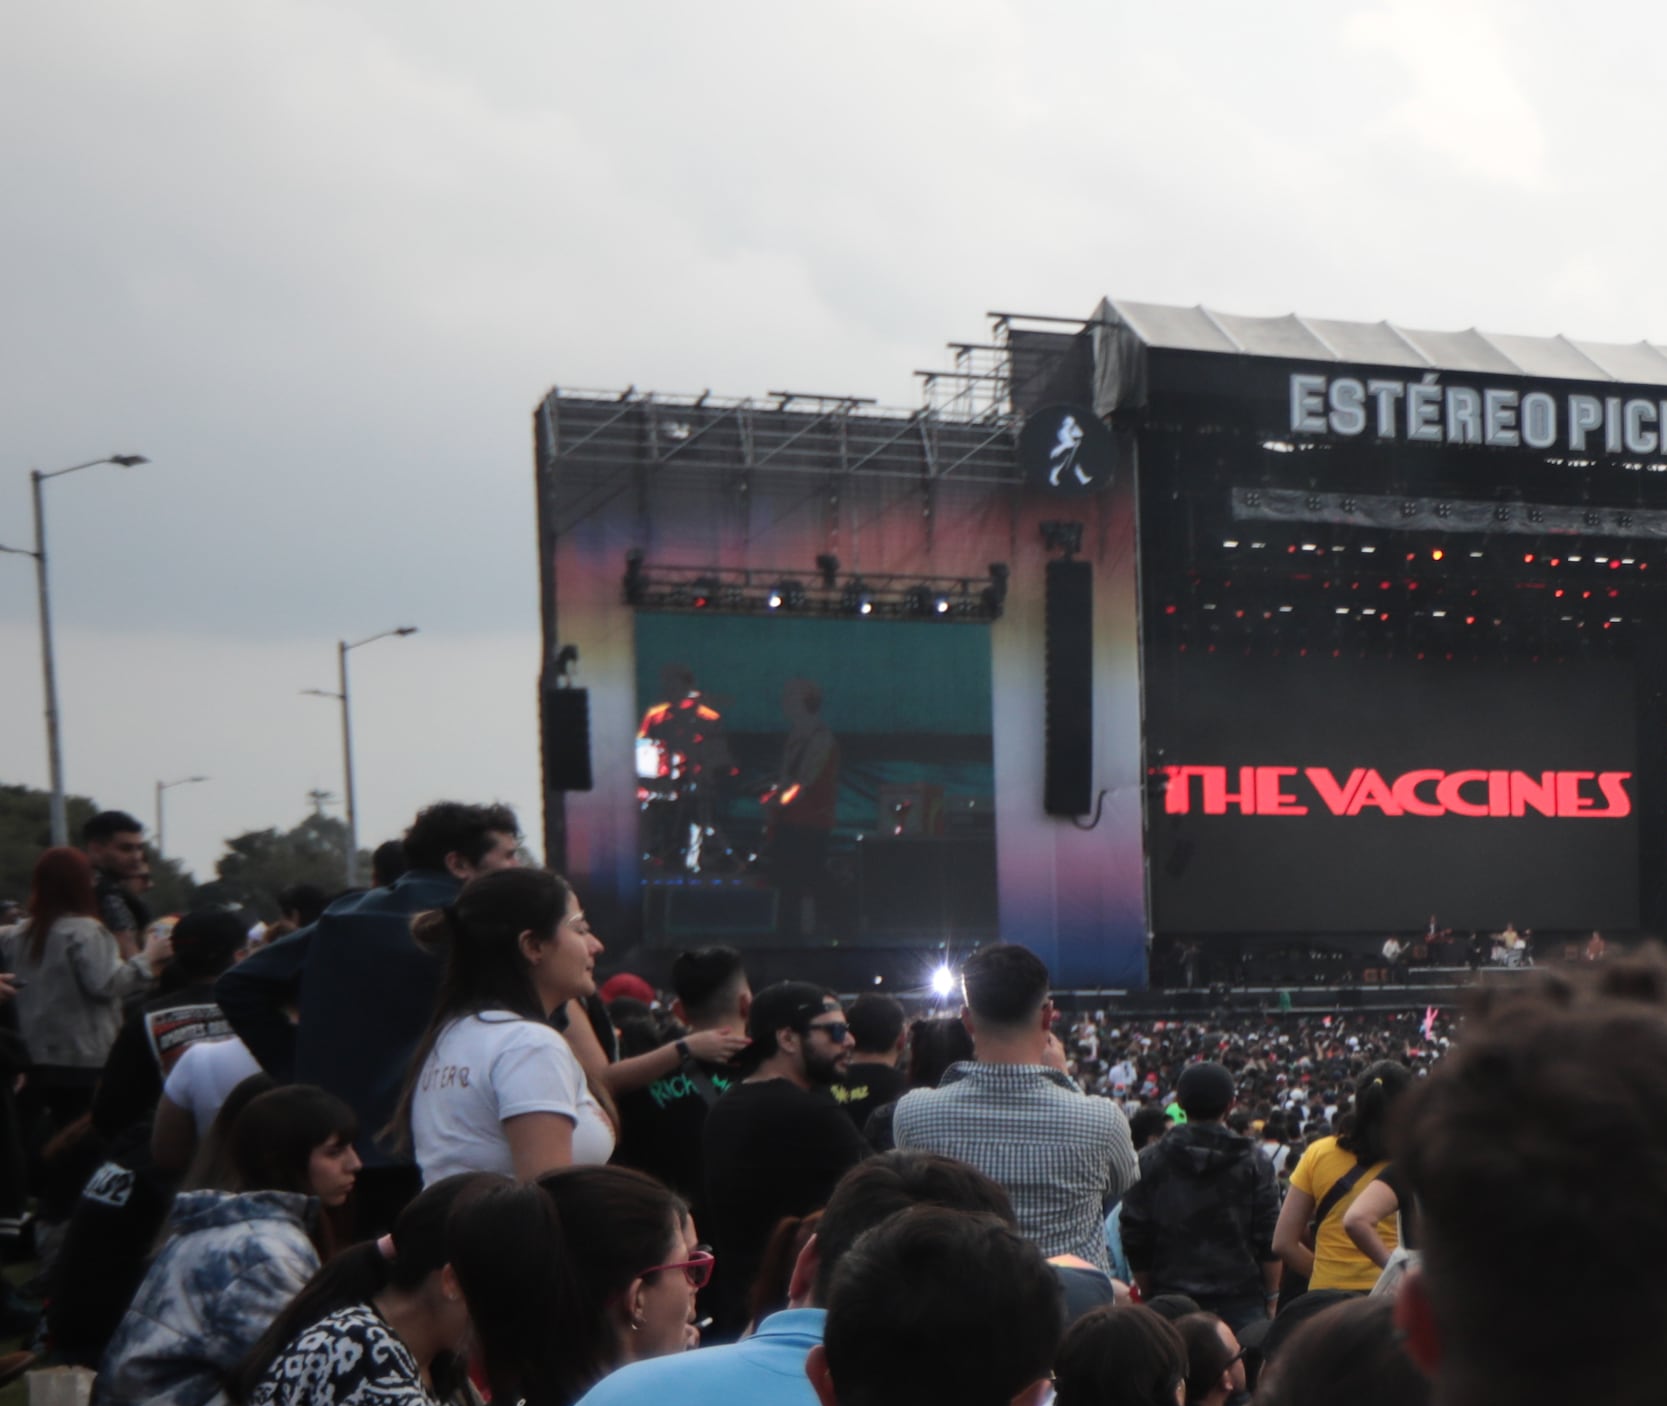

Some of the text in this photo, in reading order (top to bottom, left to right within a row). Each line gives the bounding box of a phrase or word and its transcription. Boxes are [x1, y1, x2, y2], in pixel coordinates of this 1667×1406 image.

[1288, 372, 1558, 450] ESTÉREO
[1151, 765, 1633, 819] THE VACCINES
